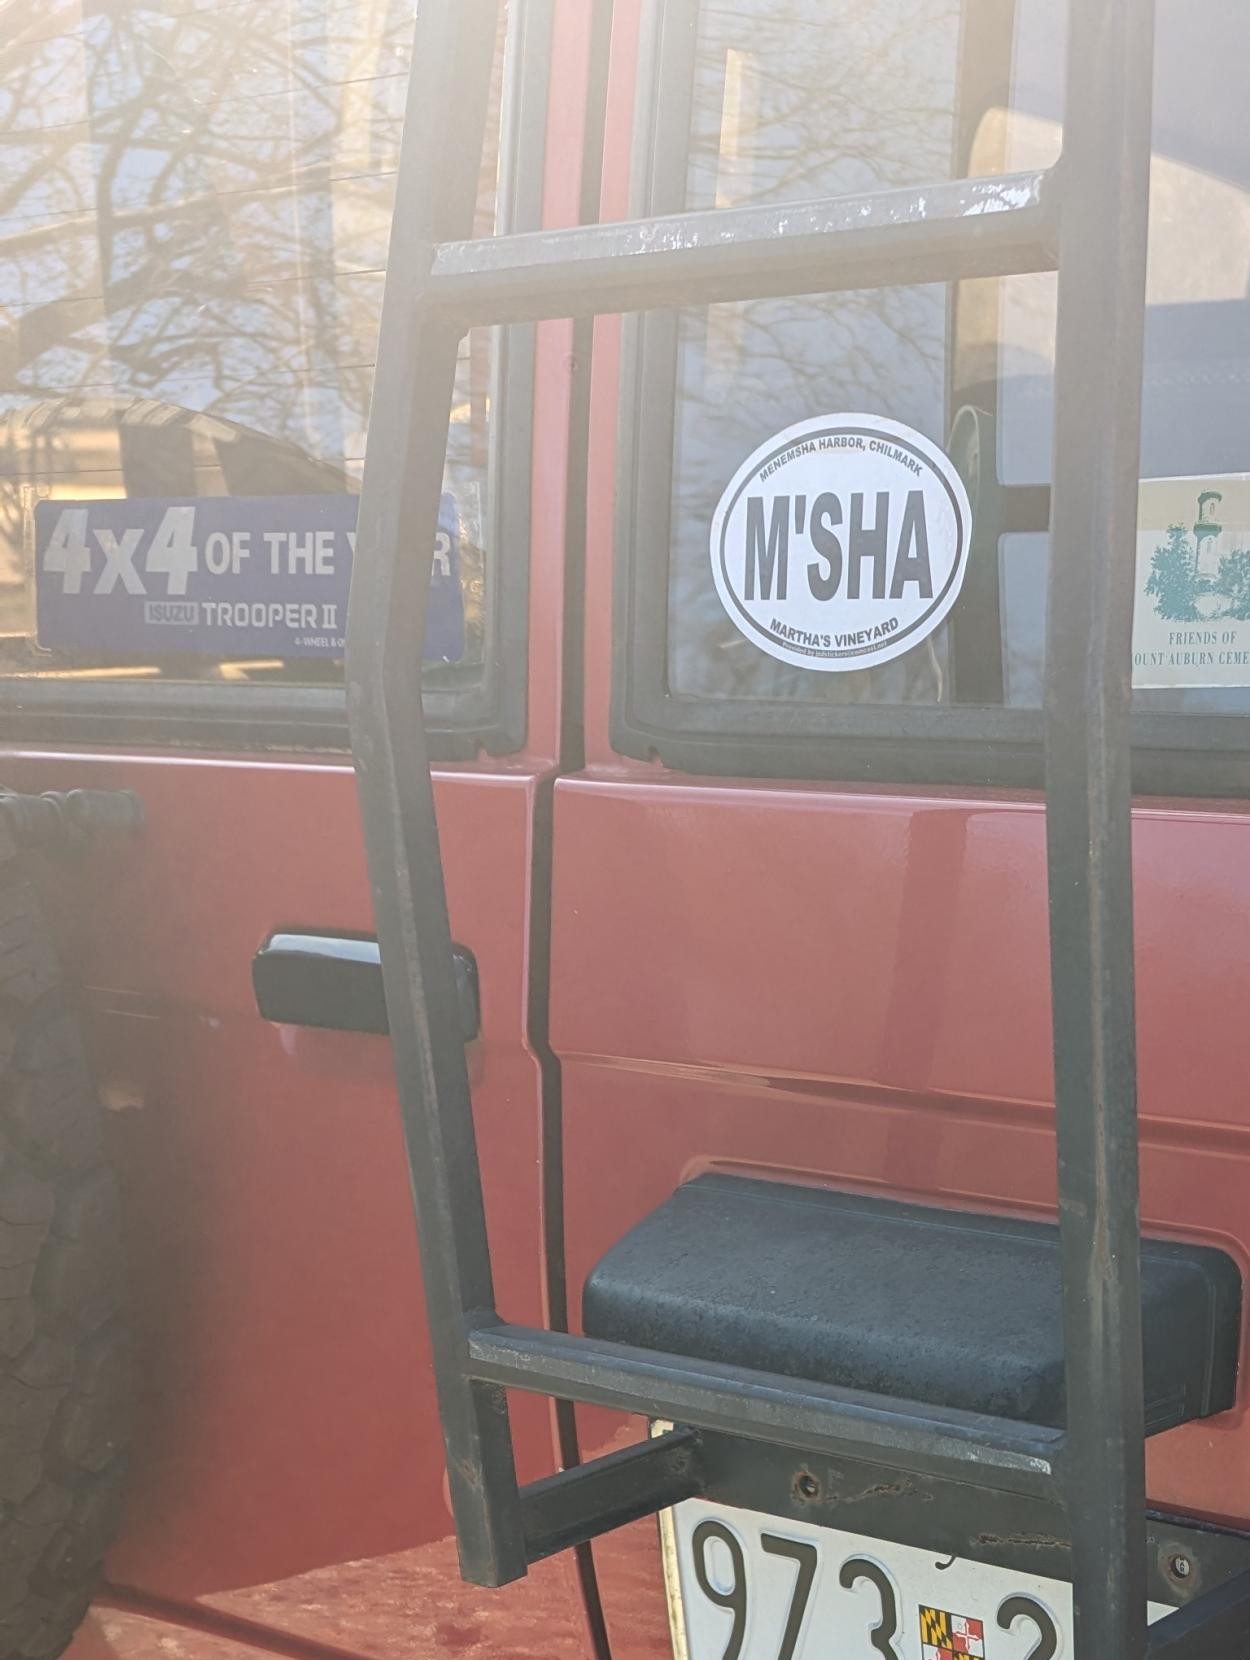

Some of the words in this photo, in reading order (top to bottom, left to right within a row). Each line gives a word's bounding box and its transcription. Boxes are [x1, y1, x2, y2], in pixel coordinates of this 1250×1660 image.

[759, 444, 816, 482] MENEMSHA
[818, 437, 866, 451] HARBOR,
[868, 440, 923, 477] CHILMARK
[205, 532, 250, 575] OF
[264, 531, 335, 575] THE
[744, 490, 934, 601] M'SHA
[147, 602, 196, 623] ISUZU
[204, 602, 316, 628] TROOPER
[769, 618, 832, 647] MARTHA'S
[834, 616, 900, 647] VINEYARD
[1169, 632, 1218, 645] FRIENDS
[1222, 631, 1237, 644] OF
[1134, 653, 1165, 665] OUNT
[1168, 652, 1214, 667] AUBURN
